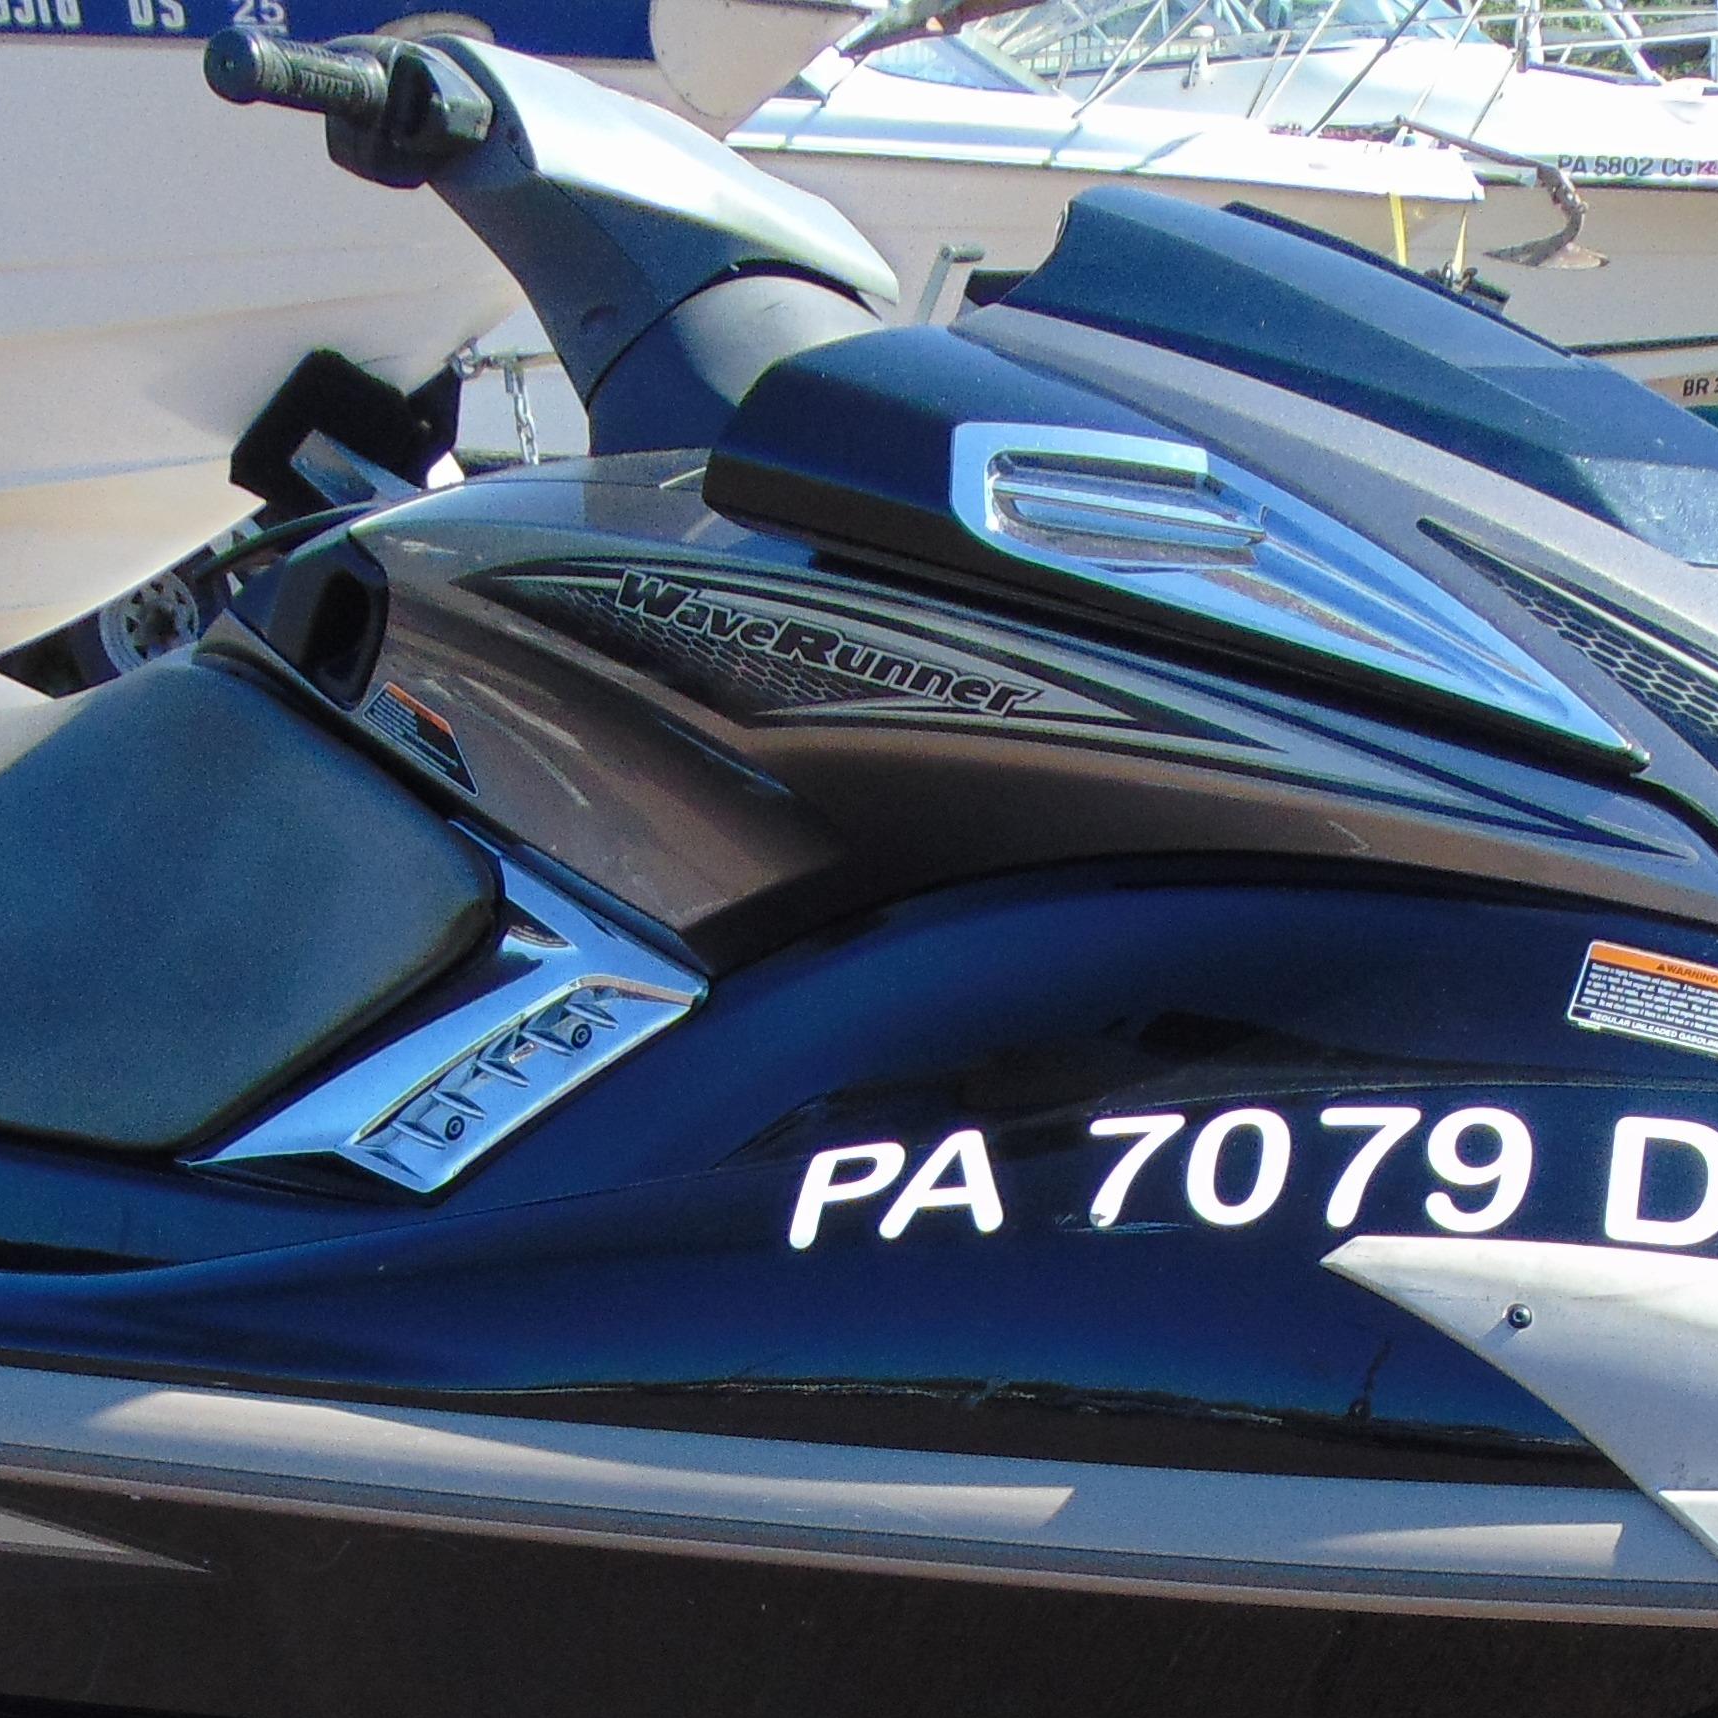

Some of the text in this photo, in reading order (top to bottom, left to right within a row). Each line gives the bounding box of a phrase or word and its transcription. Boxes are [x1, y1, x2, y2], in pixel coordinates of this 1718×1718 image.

[1557, 155, 1587, 174] PA
[1594, 155, 1655, 177] 5802
[614, 567, 1045, 716] WaveRunner
[1665, 962, 1718, 985] WARNING
[1589, 1011, 1632, 1028] REGULAR
[1631, 1021, 1678, 1039] UNLEADED
[787, 1129, 1004, 1250] PA
[1088, 1106, 1534, 1233] 7079
